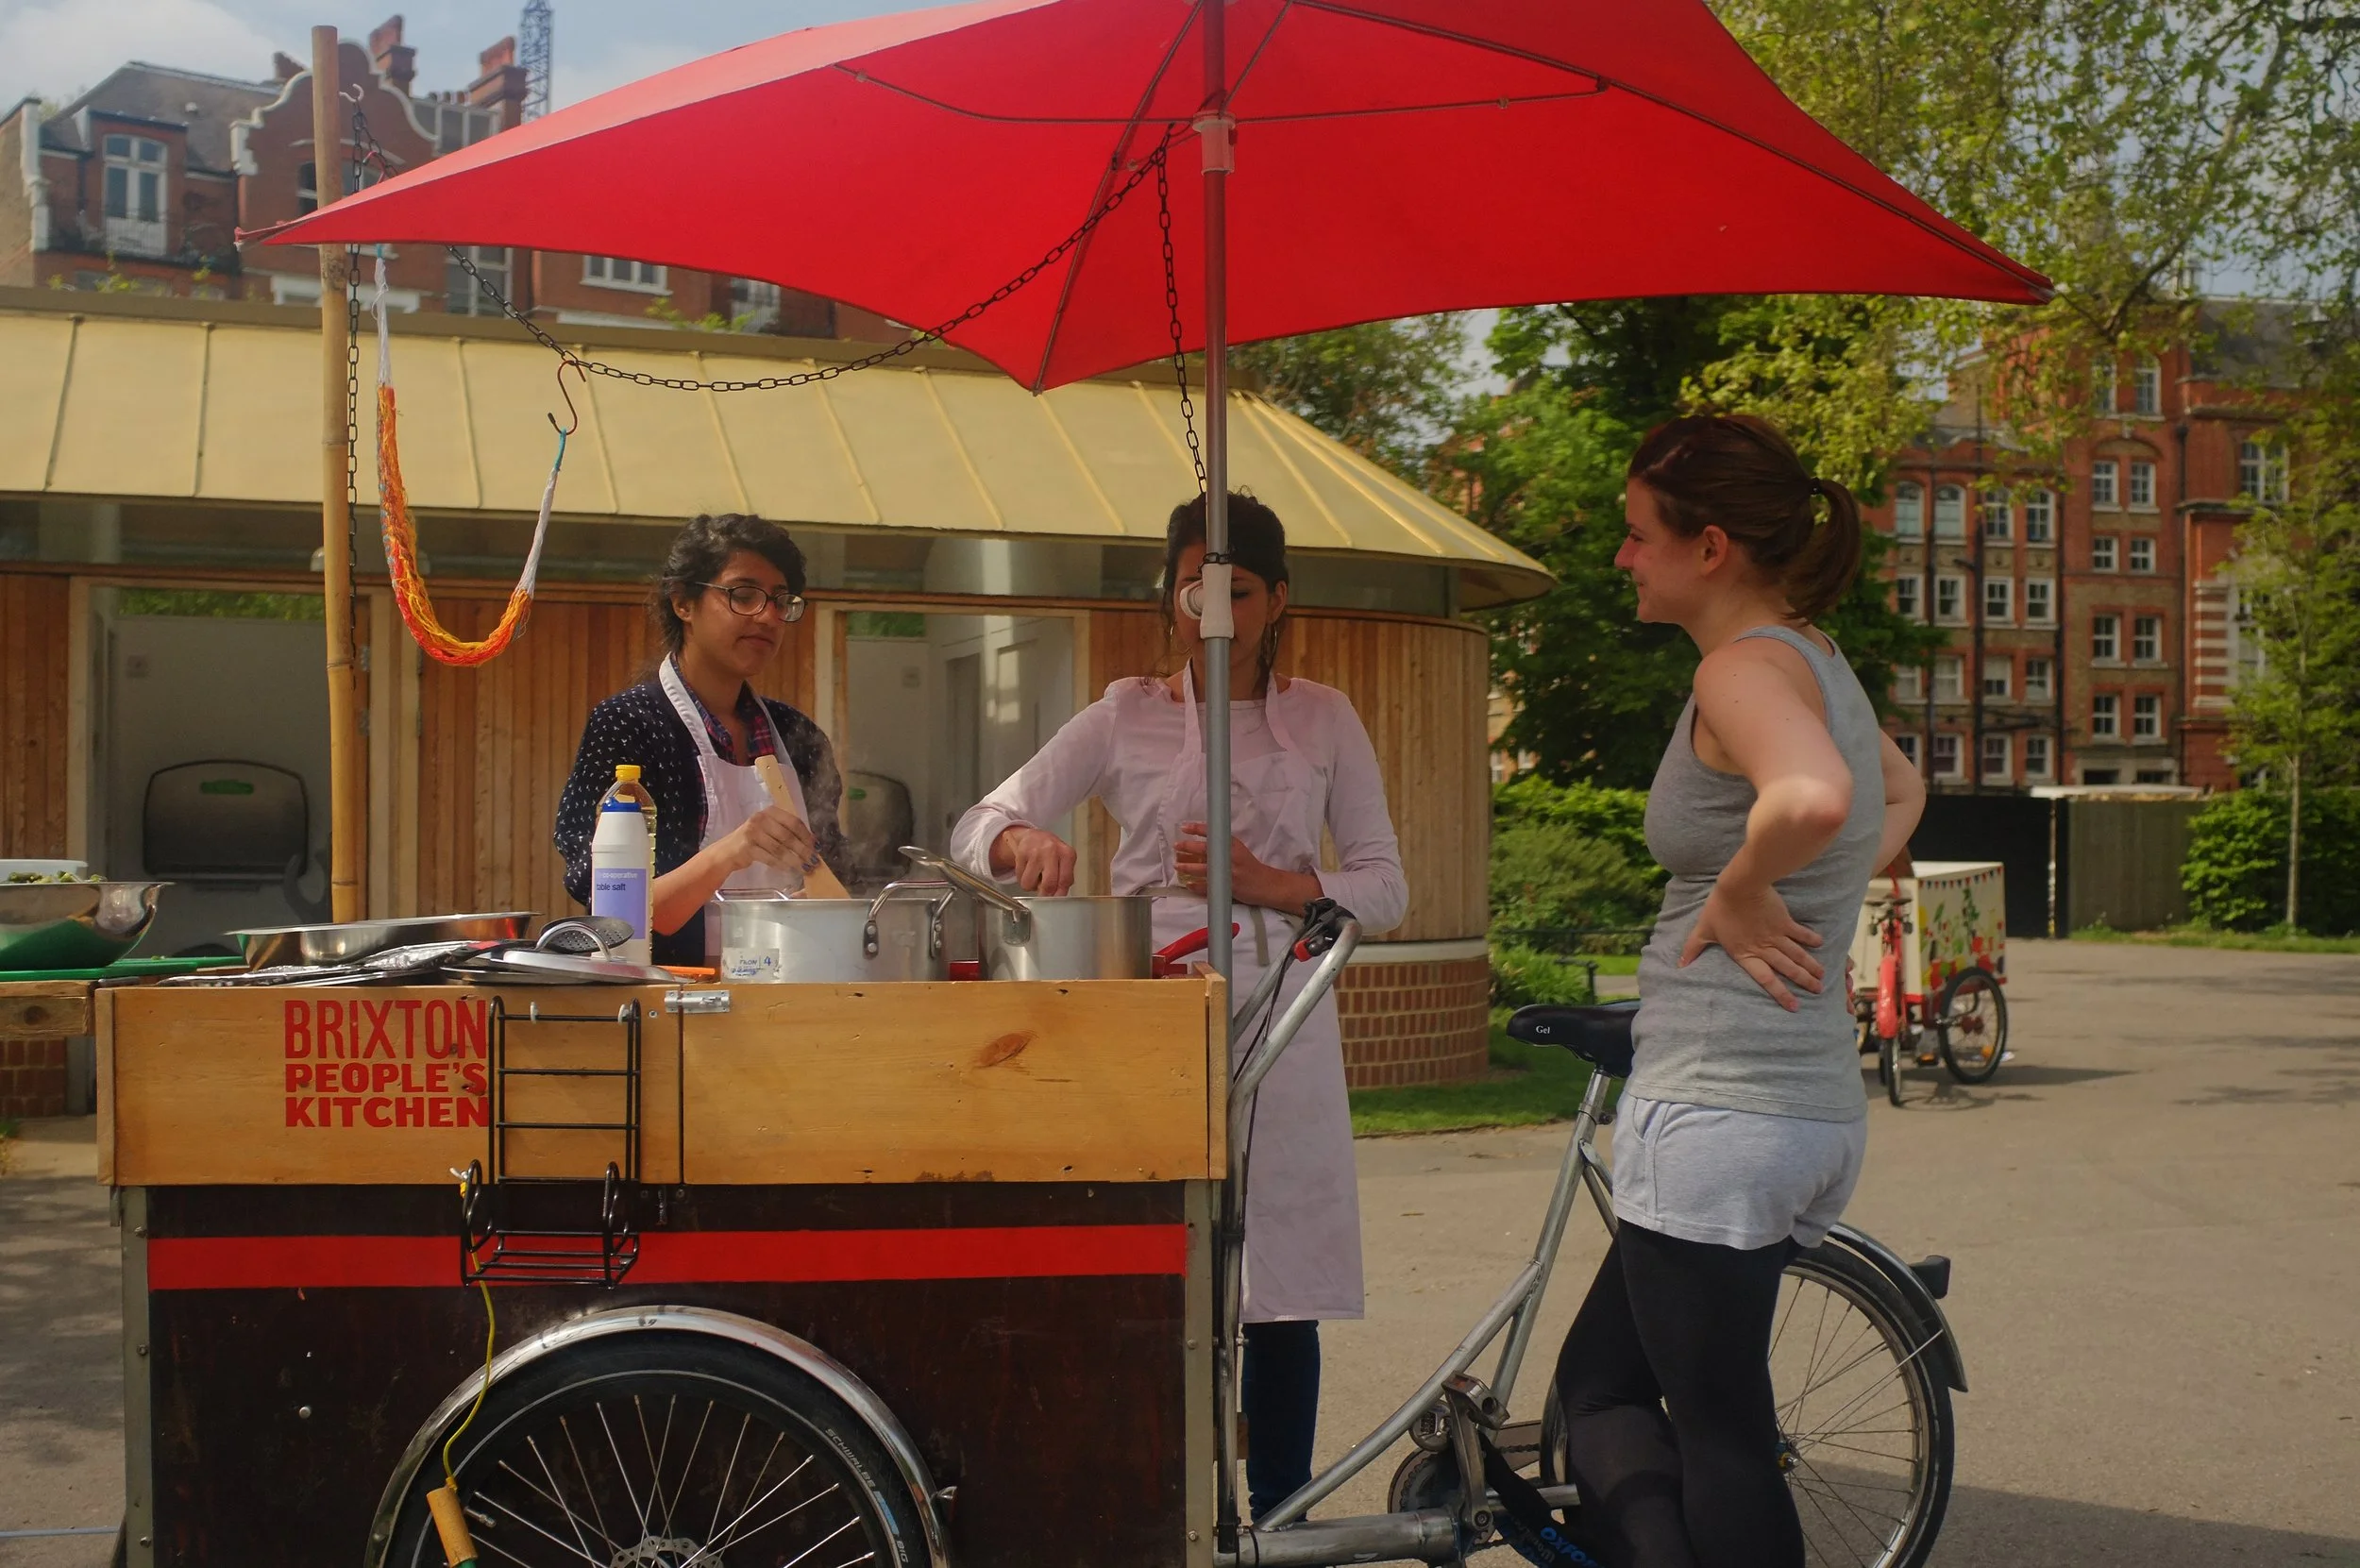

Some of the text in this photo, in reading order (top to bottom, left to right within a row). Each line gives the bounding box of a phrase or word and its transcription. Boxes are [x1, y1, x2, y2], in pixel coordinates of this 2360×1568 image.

[612, 883, 626, 891] salt
[284, 999, 487, 1059] BRIXTON
[1536, 1025, 1551, 1034] Gel
[285, 1062, 488, 1096] PEOPLE'S
[285, 1096, 489, 1128] KITCHEN
[825, 1428, 908, 1563] SCHWALBE BIG
